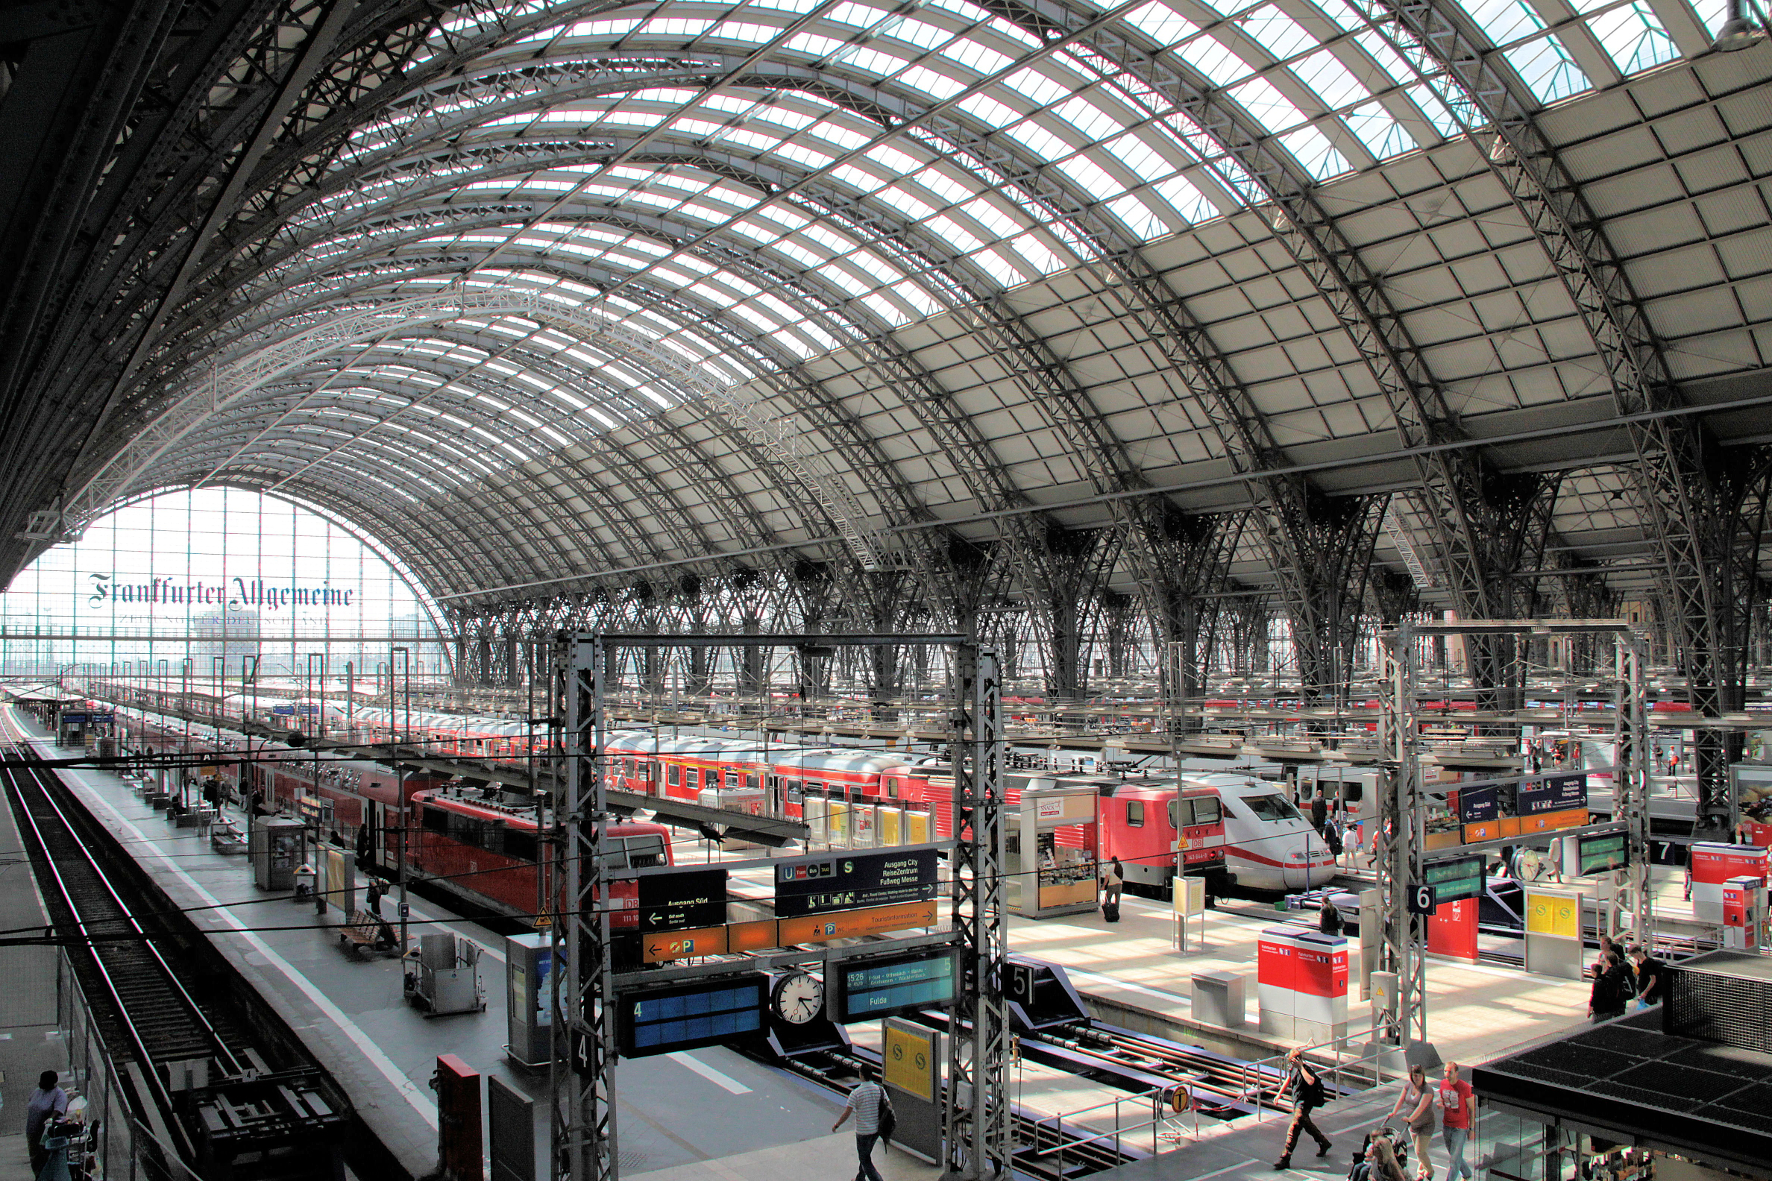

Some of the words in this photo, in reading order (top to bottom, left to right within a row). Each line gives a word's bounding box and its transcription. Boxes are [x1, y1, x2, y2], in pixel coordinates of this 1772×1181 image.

[88, 573, 226, 609] Frankfurter
[228, 577, 354, 611] Allgemeine
[534, 736, 541, 744] A
[1658, 842, 1671, 860] 7
[844, 861, 853, 874] S
[884, 860, 907, 869] Ausgang
[907, 858, 919, 867] City
[785, 867, 793, 880] U
[882, 867, 919, 877] ReiseZentrum
[880, 877, 901, 886] Fußweg
[627, 899, 639, 909] DB
[1416, 886, 1430, 909] 6
[683, 940, 691, 953] P
[944, 958, 951, 971] 5
[1013, 967, 1026, 995] 5
[869, 996, 887, 1006] Fulda
[634, 1002, 642, 1017] 4
[578, 1034, 588, 1068] 4
